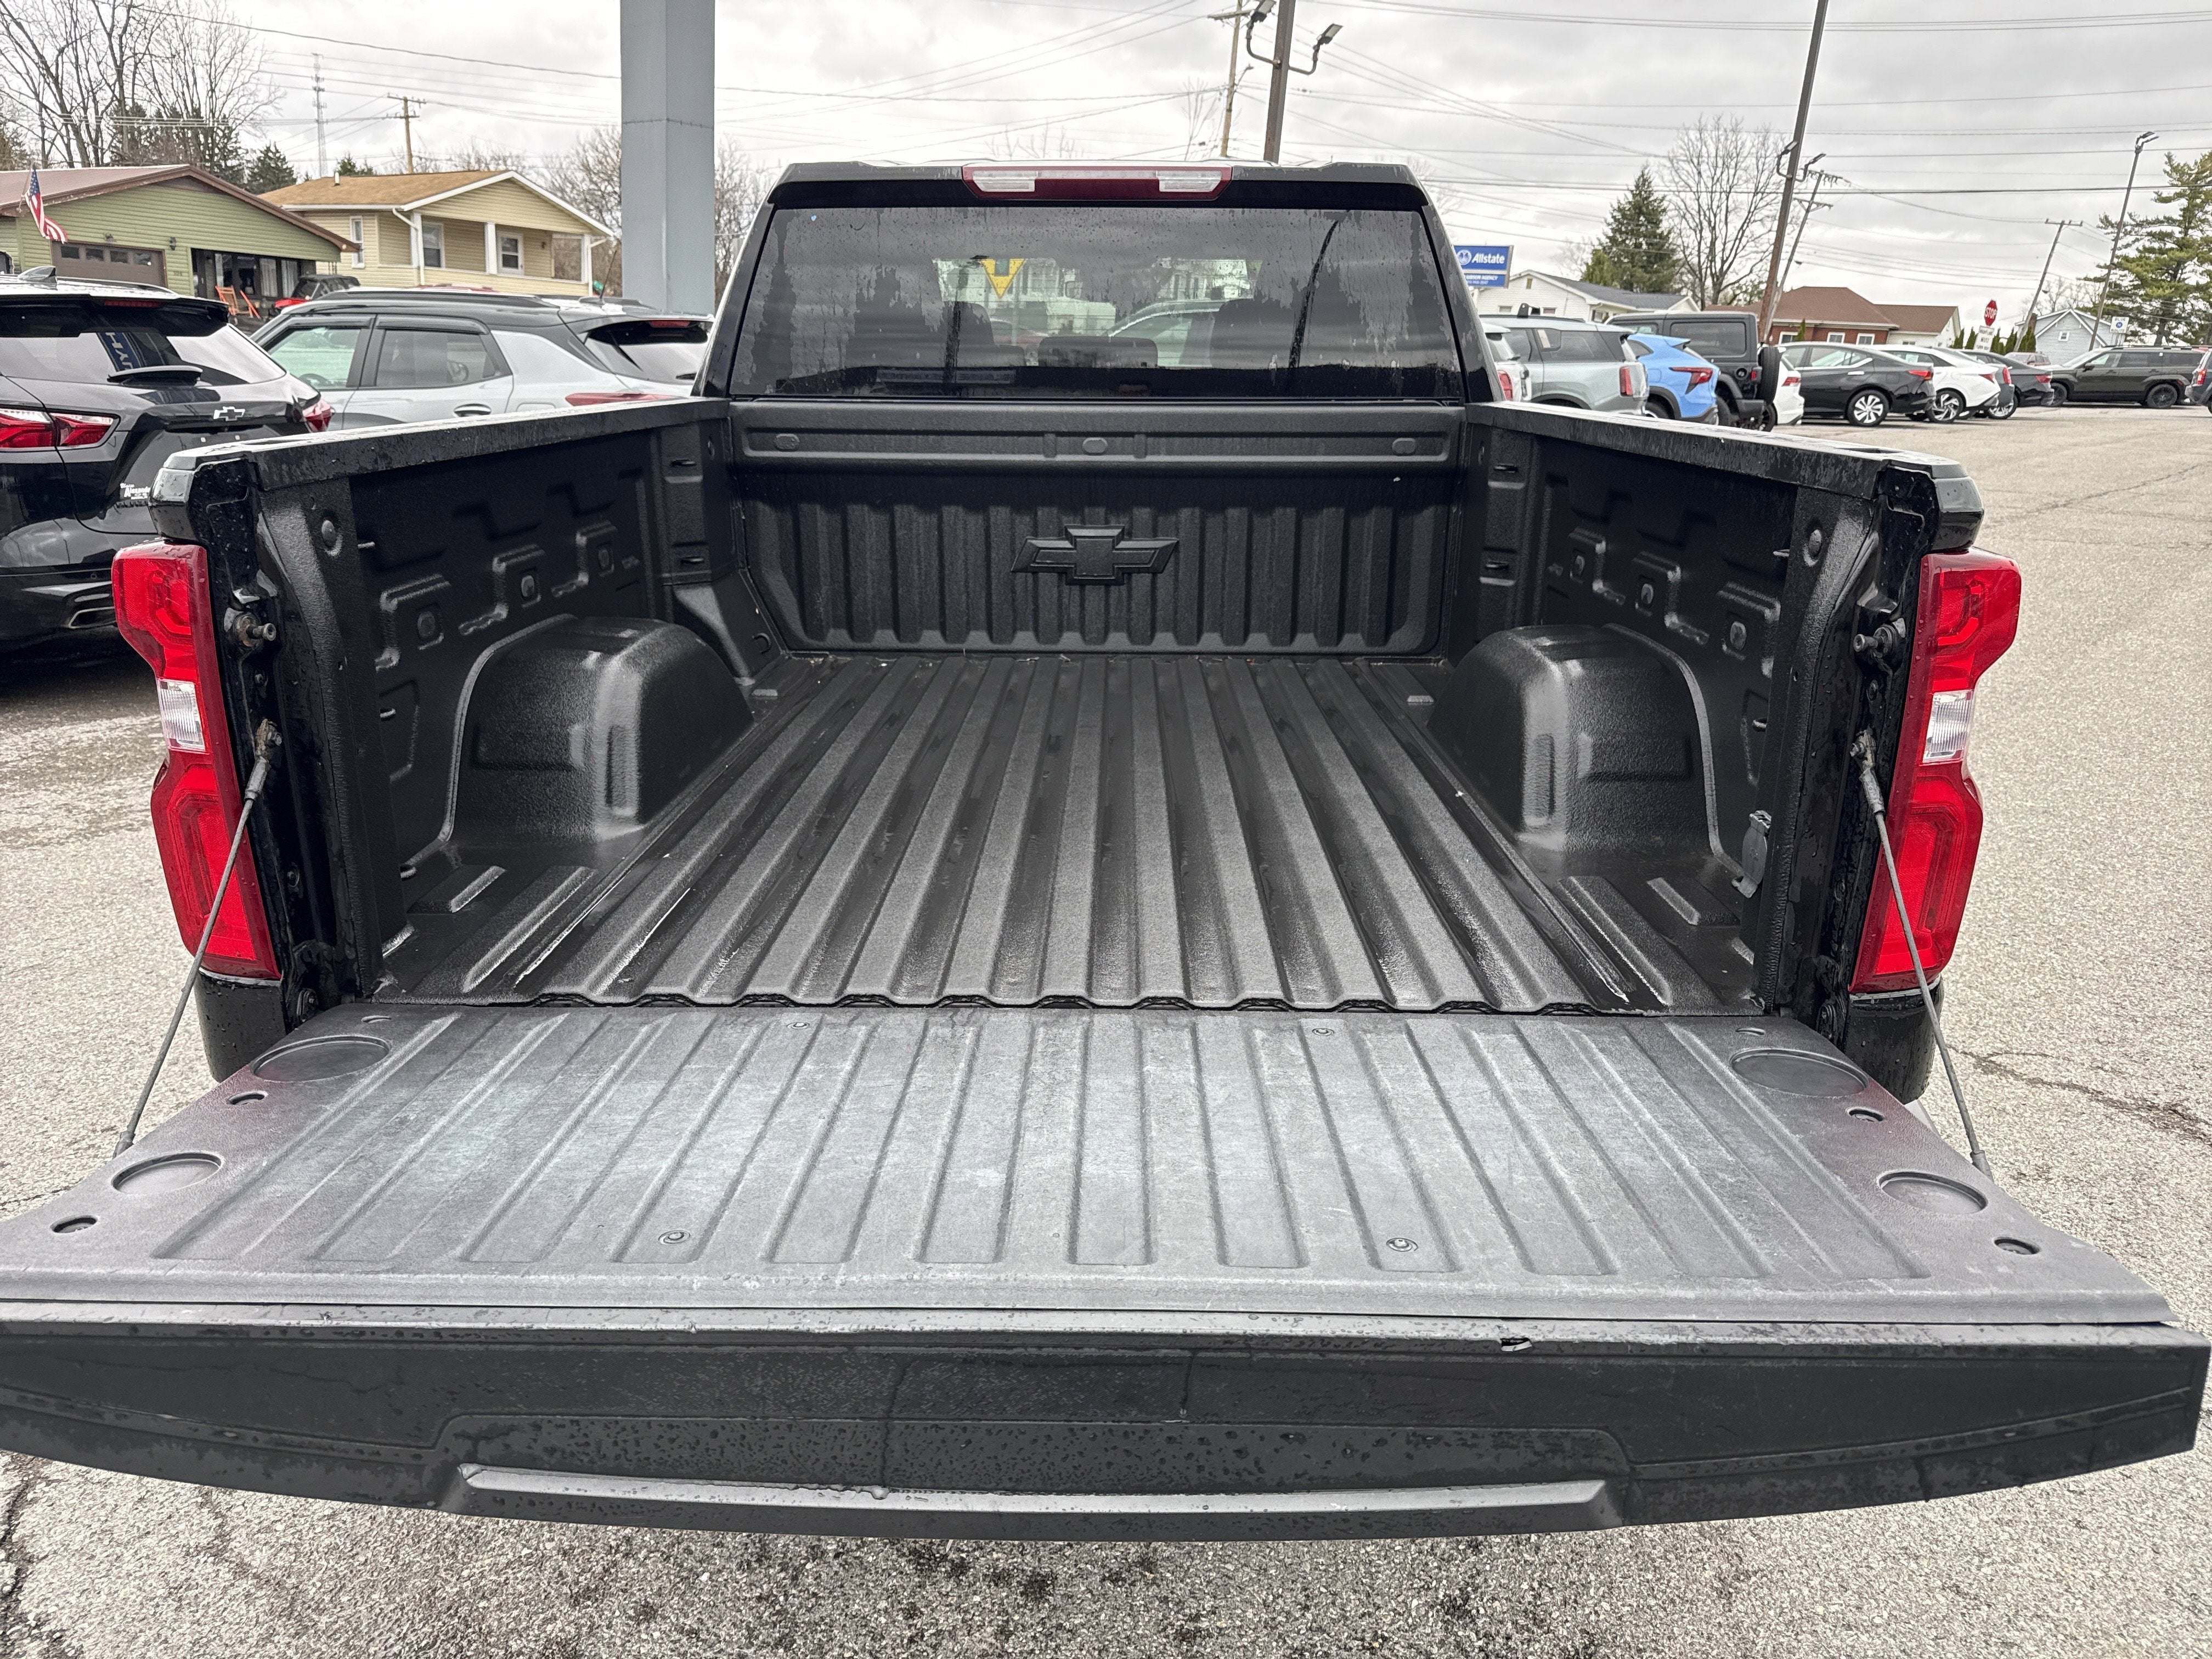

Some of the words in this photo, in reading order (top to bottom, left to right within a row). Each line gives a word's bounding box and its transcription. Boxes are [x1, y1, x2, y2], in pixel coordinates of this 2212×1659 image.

[1471, 253, 1505, 264] Allstate
[1985, 307, 1996, 319] STOP
[124, 486, 151, 497] Alexande
